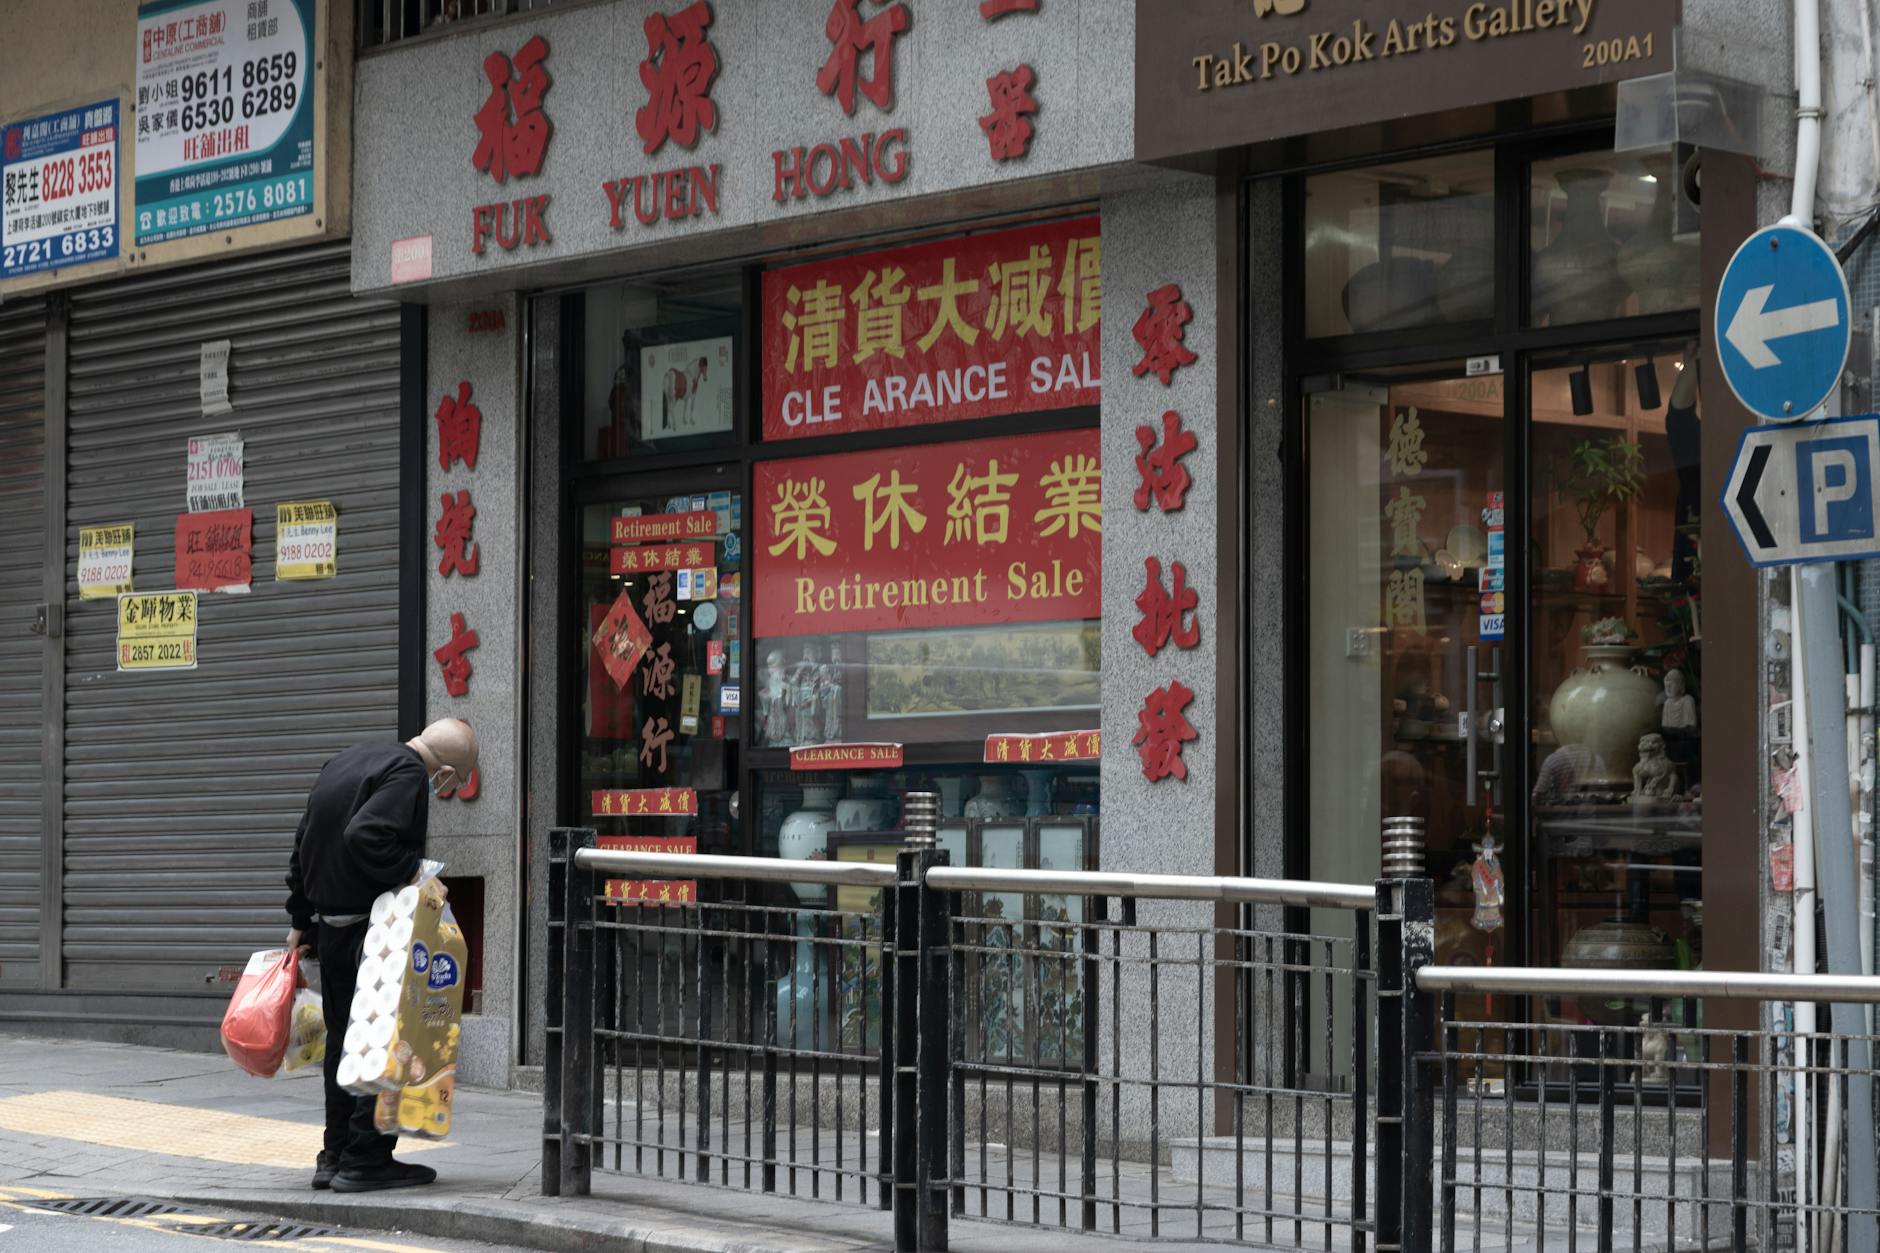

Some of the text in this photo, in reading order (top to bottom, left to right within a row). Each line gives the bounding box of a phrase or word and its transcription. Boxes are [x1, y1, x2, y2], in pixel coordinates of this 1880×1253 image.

[1193, 0, 1595, 91] Tak Po Kok Arts Gallery
[1582, 32, 1655, 69] 200A1
[182, 65, 232, 102] 9611
[242, 51, 296, 88] 8659
[181, 96, 233, 132] 6530
[242, 82, 296, 118] 6289
[42, 158, 75, 202] 8228
[78, 149, 112, 194] 3553
[471, 128, 911, 254] FUK YUEN HONG
[214, 189, 256, 217] 2576
[263, 179, 305, 207] 8081
[3, 239, 51, 268] 2721
[61, 226, 114, 255] 6833
[782, 385, 842, 427] CLE
[863, 362, 1008, 416] ARANCE
[188, 457, 241, 480] 2151 0706
[768, 454, 1101, 560] 榮休結業
[1812, 449, 1857, 535] P
[301, 526, 319, 537] Benny
[321, 525, 333, 535] Lee
[616, 515, 712, 539] Retirement Sale
[281, 543, 331, 560] 9188 0202
[622, 548, 702, 569] 榮休結業
[81, 564, 129, 583] 9188 0202
[795, 560, 1083, 614] Retirement Sale
[132, 645, 154, 661] 2857
[158, 643, 181, 660] 2022
[640, 571, 676, 773] 福源行
[725, 692, 738, 701] VISA
[796, 746, 899, 761] CLEARANCE SALE
